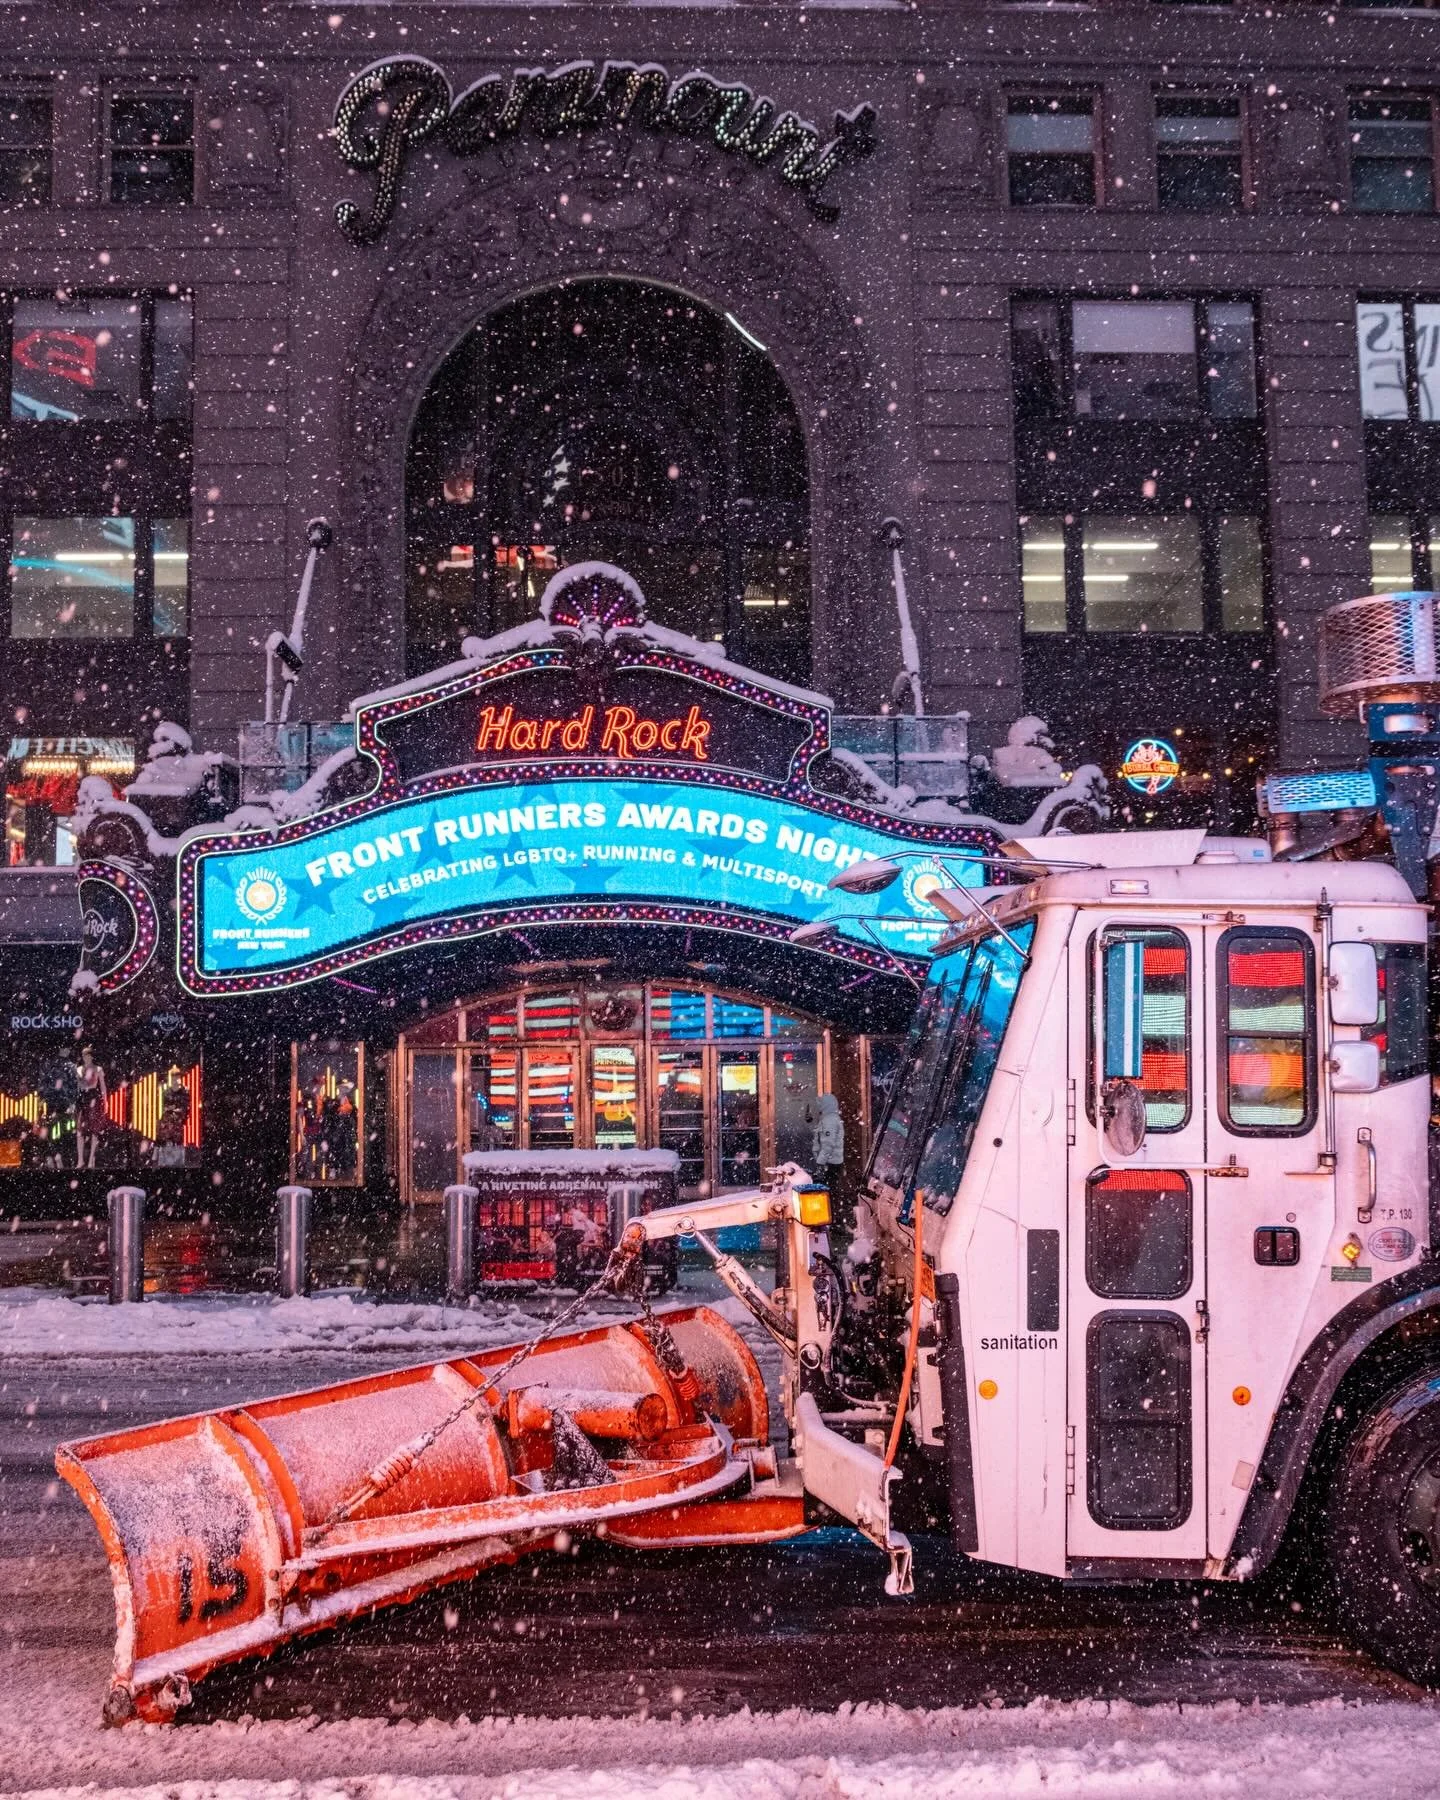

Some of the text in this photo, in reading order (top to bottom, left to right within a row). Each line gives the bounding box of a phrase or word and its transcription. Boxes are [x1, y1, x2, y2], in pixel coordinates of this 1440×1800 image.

[333, 53, 877, 246] Paramount
[477, 705, 711, 759] Hard Rock
[305, 826, 424, 887] FRONT
[434, 802, 607, 846] RUNNERS
[617, 803, 768, 843] AWARDS
[362, 845, 828, 904] CELEBRATING LGBTQ+ RUNNING & MULTISPORT
[91, 918, 118, 937] Rock
[12, 1016, 49, 1029] ROCK
[491, 1181, 547, 1191] RIVETING
[1400, 1208, 1413, 1219] 130
[981, 1334, 1058, 1350] sanitation
